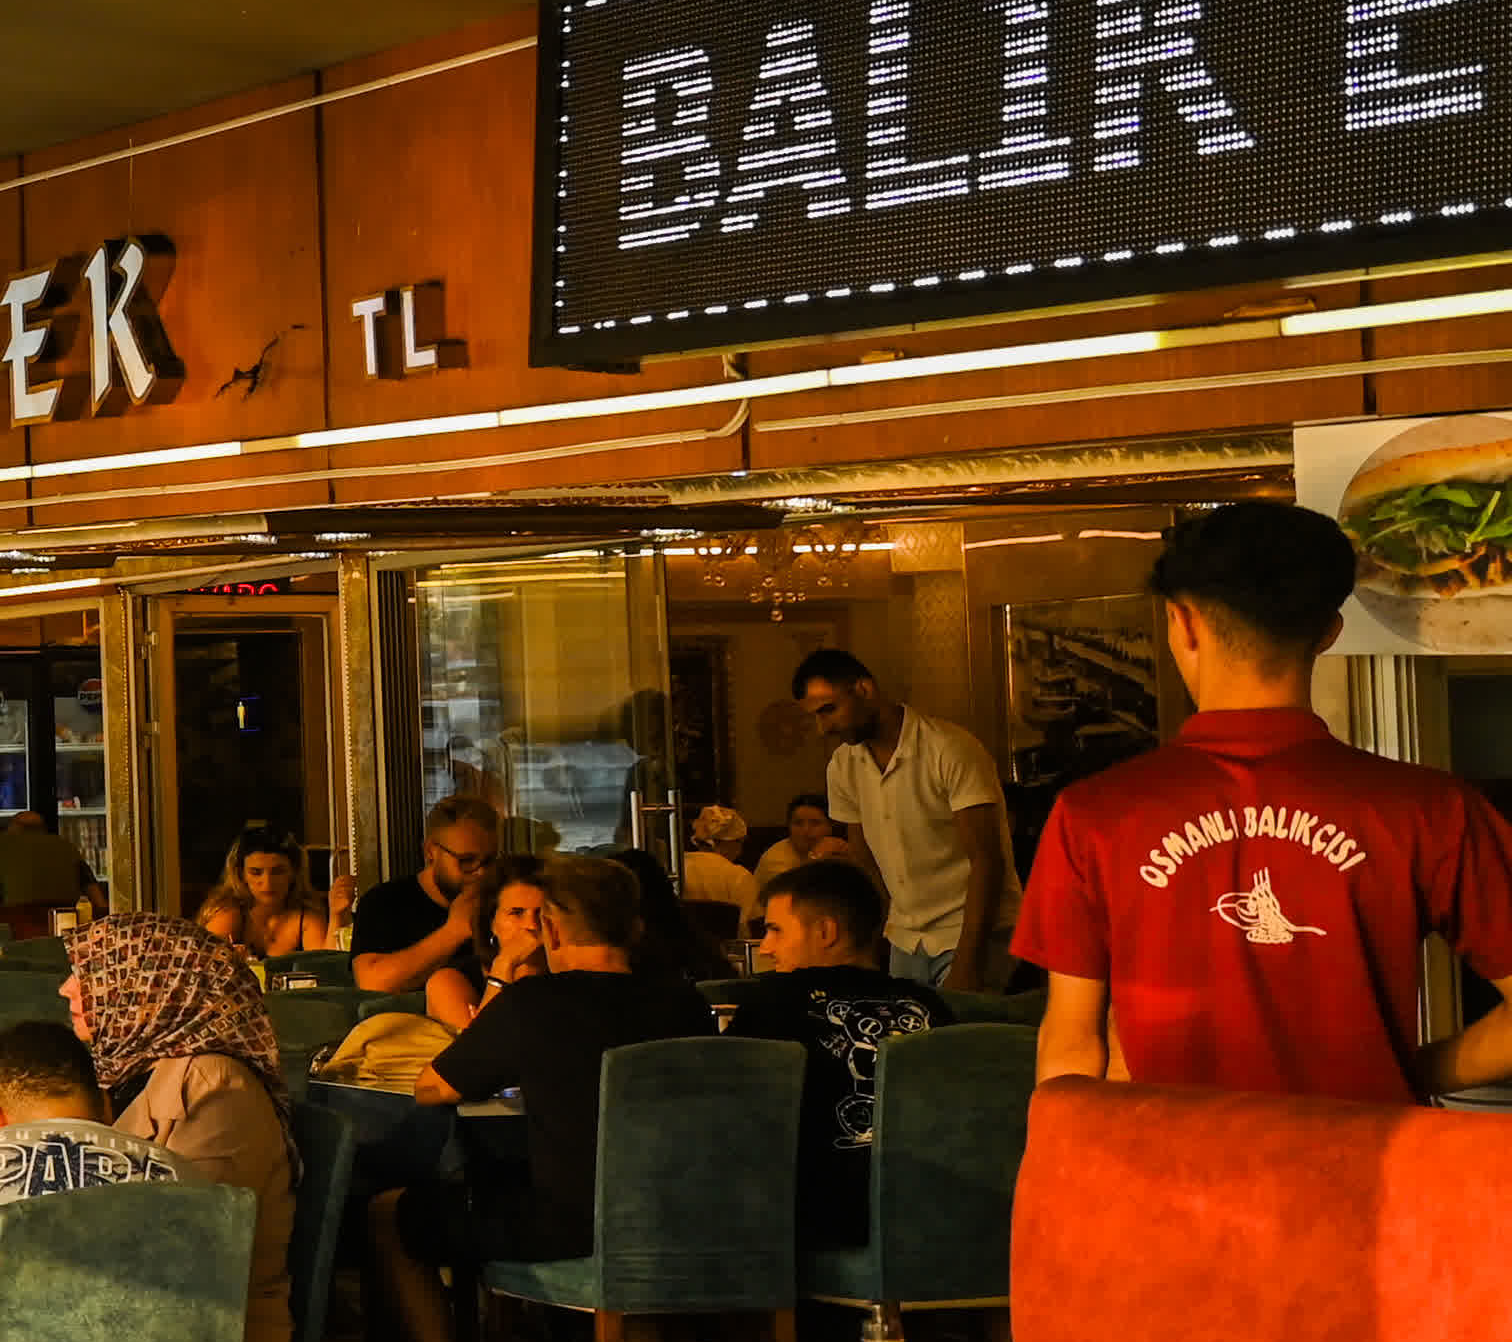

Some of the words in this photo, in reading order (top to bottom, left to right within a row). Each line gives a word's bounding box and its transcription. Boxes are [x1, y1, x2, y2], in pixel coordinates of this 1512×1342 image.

[351, 286, 439, 378] TL
[1139, 809, 1240, 888] OSMANLI
[1243, 805, 1367, 872] BALIKÇISI
